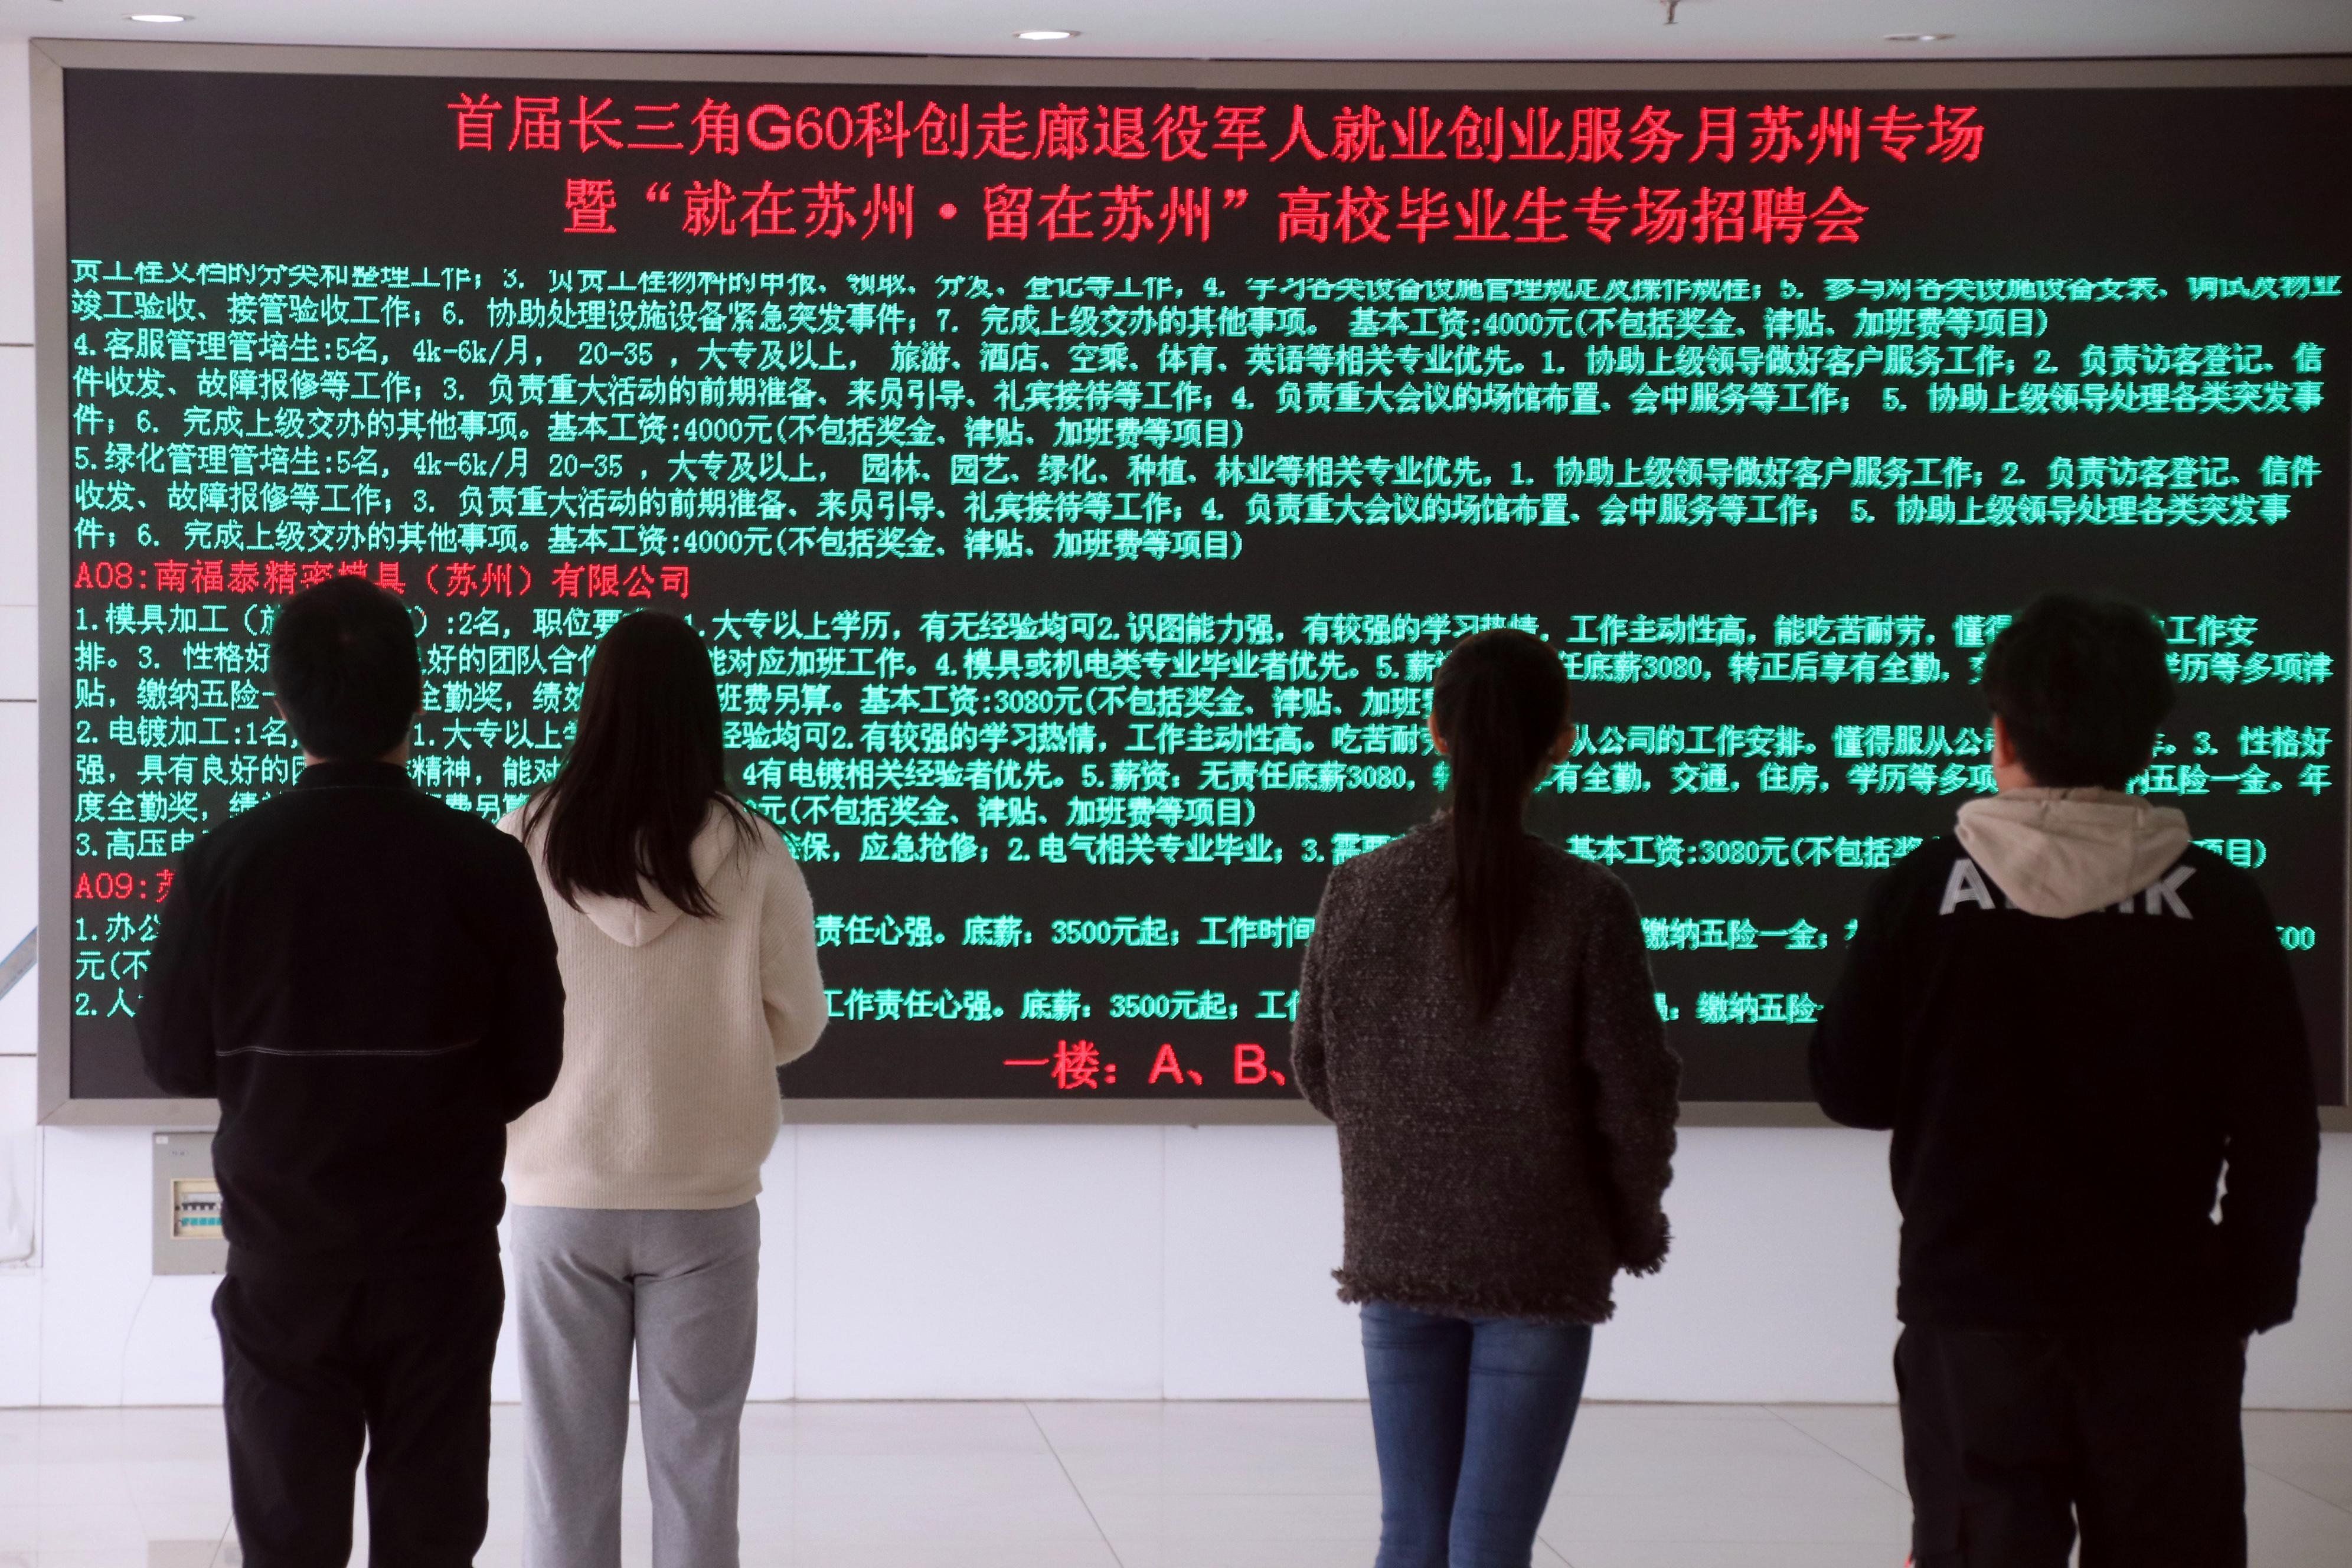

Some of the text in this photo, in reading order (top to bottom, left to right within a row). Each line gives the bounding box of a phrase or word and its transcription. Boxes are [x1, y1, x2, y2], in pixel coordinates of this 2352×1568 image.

[447, 92, 1985, 165] 首届长三角G60科创走廊退役军人就业创业服务月苏州专场
[71, 288, 207, 324] 竣工验收、
[226, 291, 420, 328] 接管验收工作；
[981, 303, 1317, 339] 完成上级交办的其他事项。
[1763, 306, 1835, 341] 津贴、
[1852, 306, 2048, 341] 加班费等项目)
[73, 327, 389, 366] 4.客服管理管培生:5名，
[412, 334, 542, 366] 4k-6k/月，
[579, 341, 653, 366] 20-35
[697, 338, 857, 372] 大专及以上，
[890, 340, 961, 374] 旅游、
[979, 341, 1049, 373] 酒店、
[1067, 342, 1138, 374] 空乘、
[1156, 342, 1227, 376] 体育、
[1244, 343, 1524, 377] 英语等相关专业优先。
[2079, 342, 2274, 378] 负责访客登记、
[72, 364, 177, 400] 件收发、
[196, 367, 421, 404] 故障报修等工作；
[489, 372, 827, 410] 负责重大活动的前期准备、
[845, 377, 975, 411] 来员引导、
[993, 378, 1212, 413] 礼宾接待等工作；
[1275, 380, 1611, 416] 负责重大会议的场馆布置、
[1628, 381, 1850, 416] 会中服务等工作；
[1926, 380, 2324, 415] 协助上级领导处理各类突发事
[182, 404, 529, 442] 完成上级交办的其他事项。
[963, 416, 1034, 449] 津贴、
[1052, 416, 1243, 450] 加班费等项目)
[74, 441, 389, 479] 5.绿化管理管培生:5名，
[413, 447, 528, 479] 4k-6k/月
[549, 453, 623, 478] 20-35
[667, 450, 827, 484] 大专及以上，
[861, 452, 930, 485] 园林、
[950, 453, 1019, 486] 园艺、
[1037, 453, 1108, 486] 绿化、
[1126, 453, 1197, 487] 种植、
[2046, 455, 2240, 490] 负责访客登记、
[74, 478, 146, 512] 收发、
[166, 480, 391, 515] 故障报修等工作；
[459, 485, 797, 521] 负责重大活动的前期准备、
[815, 488, 945, 522] 来员引导、
[963, 490, 1182, 524] 礼宾接待等工作；
[1245, 492, 1580, 527] 负责重大会议的场馆布置、
[1597, 493, 1818, 527] 会中服务等工作；
[1894, 492, 2291, 527] 协助上级领导处理各类突发事
[184, 518, 530, 555] 完成上级交办的其他事项。
[963, 527, 1034, 560] 津贴、
[1052, 527, 1242, 561] 加班费等项目)
[1566, 613, 1756, 647] 工作主动性高，
[1773, 613, 1935, 648] 能吃苦耐劳，
[421, 643, 597, 677] 好的团队合
[1727, 651, 1950, 685] 转正后享有全勤，
[1271, 685, 1342, 719] 津贴、
[76, 714, 300, 749] 2.电镀加工:1名，
[1124, 721, 1315, 756] 工作主动性高。
[2237, 725, 2333, 759] 性格好
[742, 756, 1064, 791] 4有电镀相关经验者优先。
[1081, 758, 1180, 792] 5.薪资：
[1197, 759, 1416, 793] 无责任底薪3080，
[1670, 761, 1740, 795] 交通，
[1756, 762, 1830, 795] 住房，
[74, 789, 208, 824] 度全勤奖，
[976, 794, 1047, 828] 津贴、
[1065, 795, 1256, 829] 加班费等项目)
[76, 827, 209, 860] 3.高压电
[858, 831, 988, 863] 应急抢修；
[1007, 831, 1283, 866] 2.电气相关专业毕业；
[961, 914, 1032, 948] 底薪：
[1051, 914, 1180, 946] 3500元起；
[1020, 988, 1091, 1021] 底薪：
[1109, 988, 1238, 1020] 3500元起；
